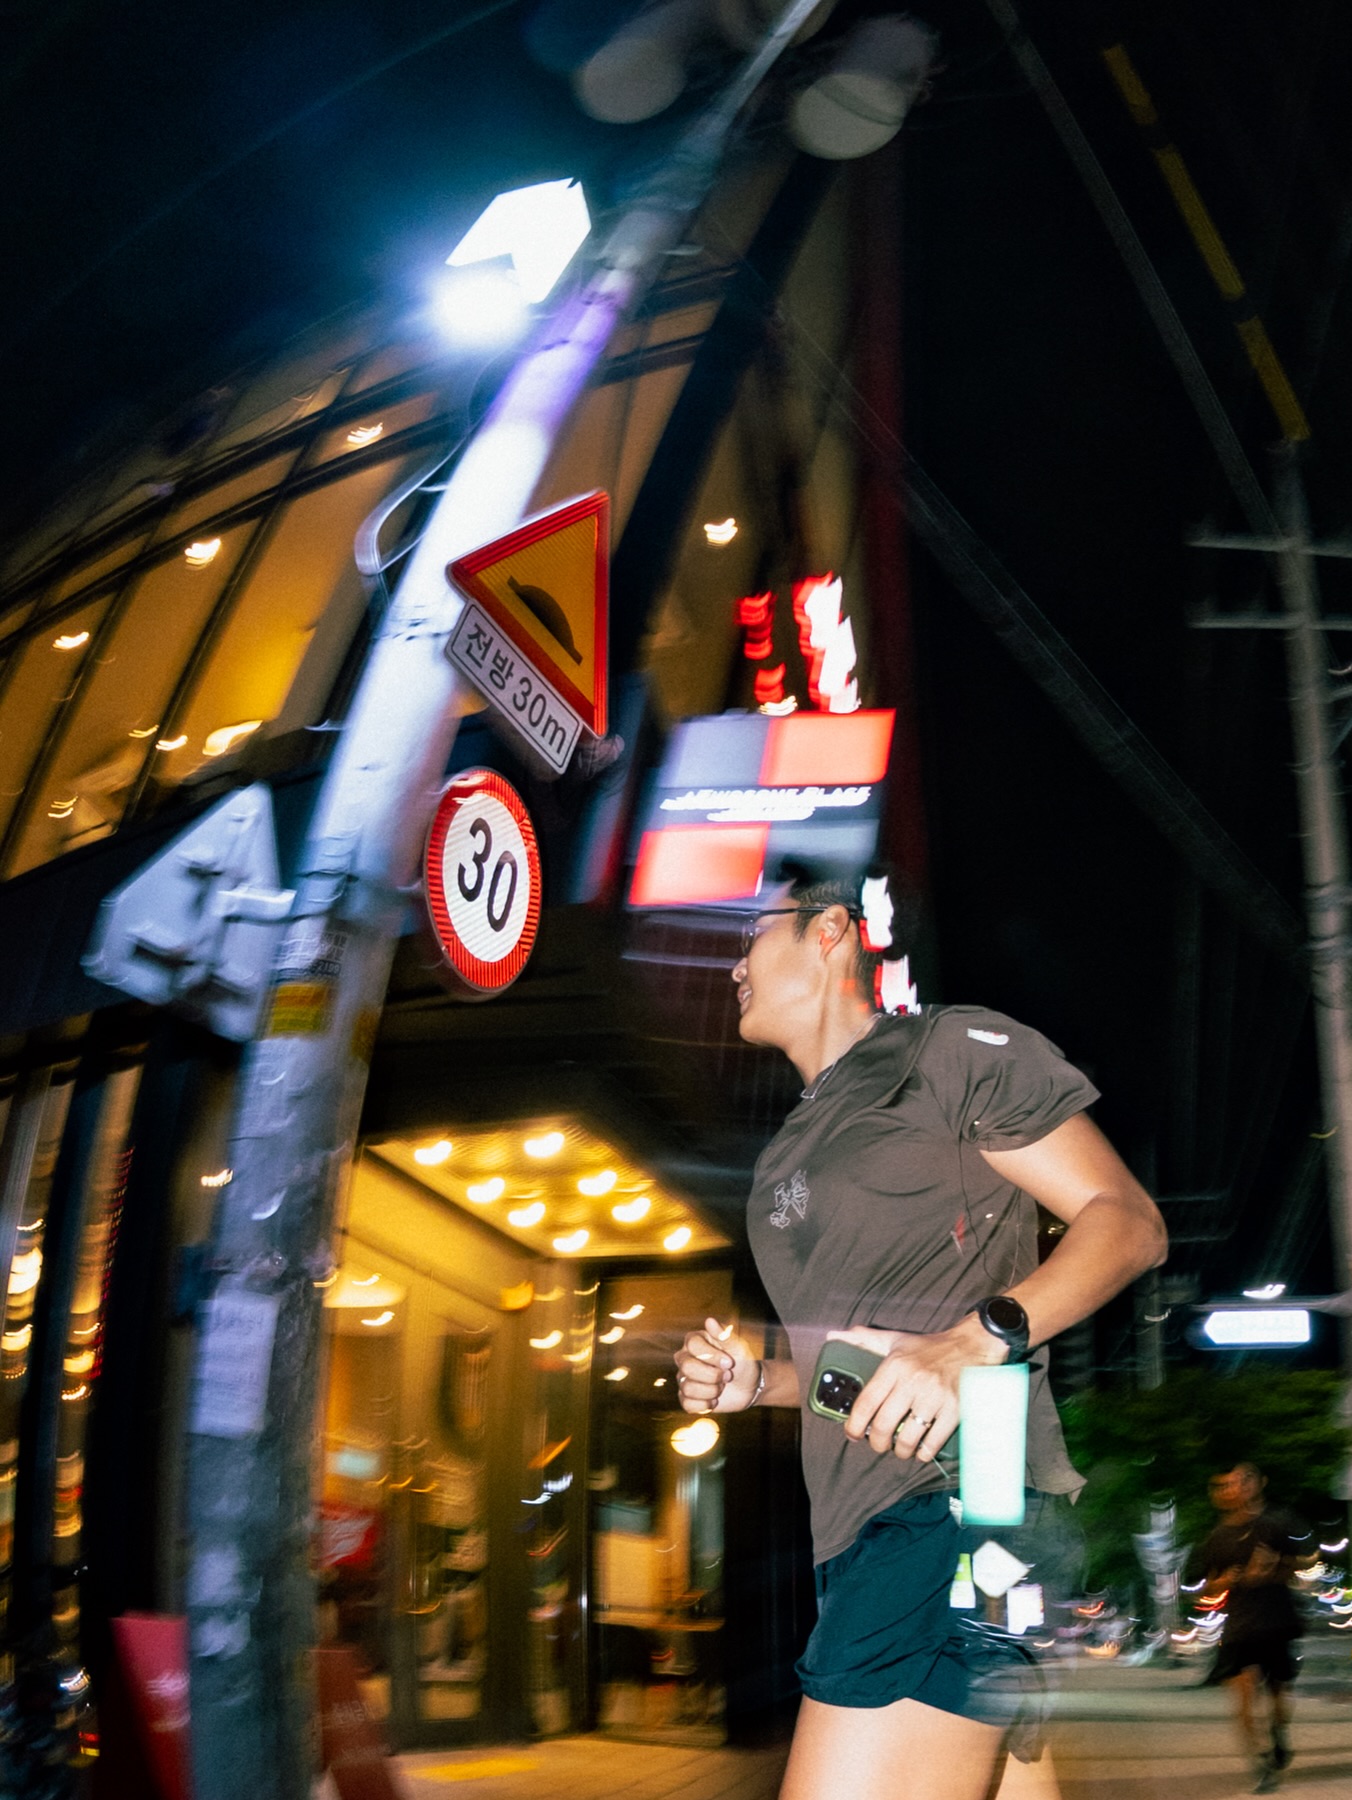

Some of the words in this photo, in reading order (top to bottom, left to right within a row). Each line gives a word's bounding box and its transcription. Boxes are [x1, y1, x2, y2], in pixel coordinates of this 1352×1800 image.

[467, 622, 515, 690] 전방
[512, 676, 567, 755] 30m
[457, 816, 518, 933] 30
